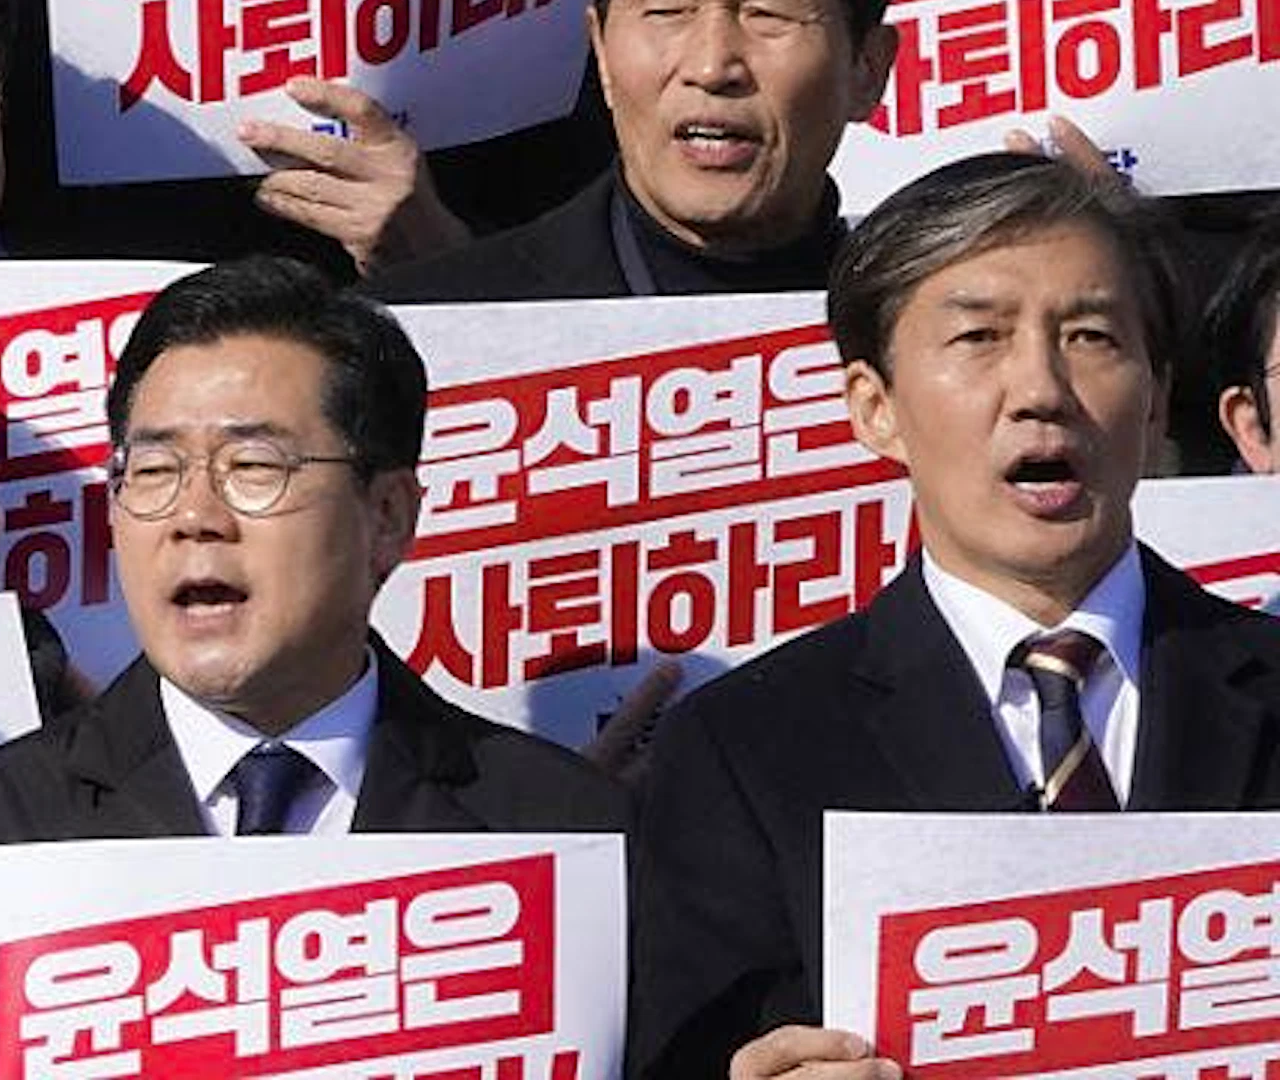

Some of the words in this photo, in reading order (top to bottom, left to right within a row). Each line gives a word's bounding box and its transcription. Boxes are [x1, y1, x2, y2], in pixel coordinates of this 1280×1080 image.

[416, 341, 880, 538] 윤석열은
[20, 881, 524, 1080] 윤석열은
[908, 881, 1280, 1067] 윤석열
